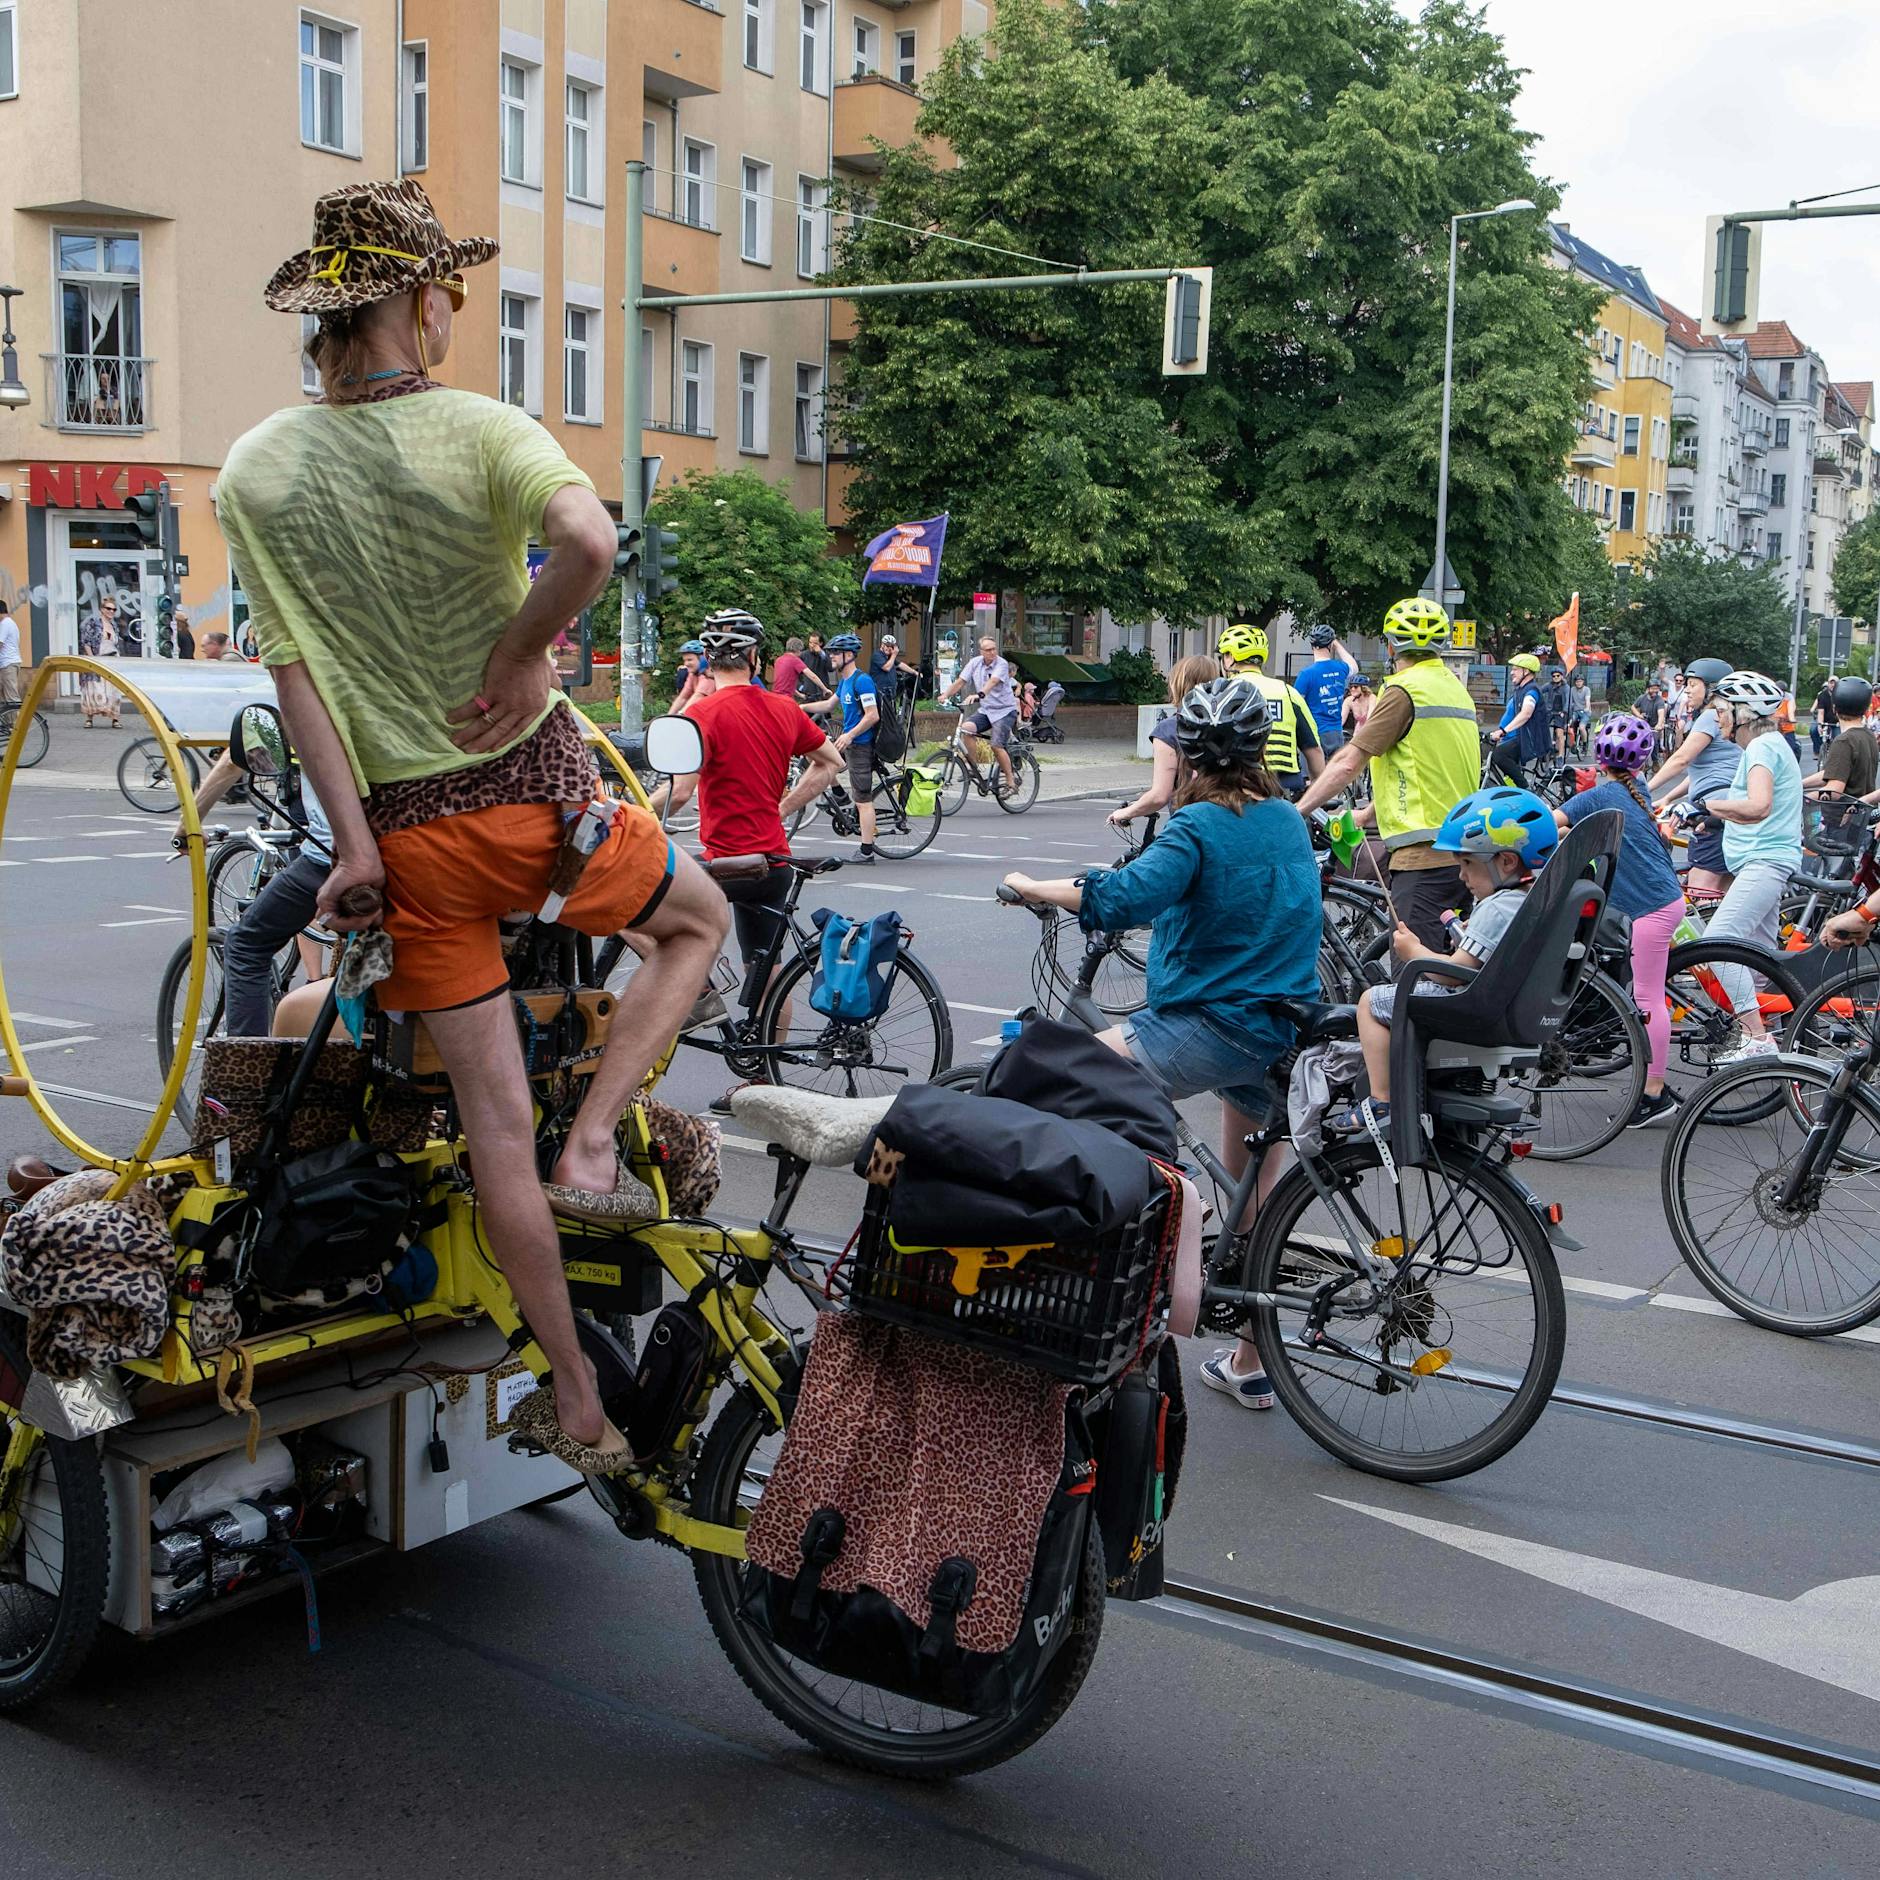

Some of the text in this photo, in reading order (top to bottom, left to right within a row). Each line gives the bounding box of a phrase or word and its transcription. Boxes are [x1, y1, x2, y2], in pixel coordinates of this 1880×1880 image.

[30, 463, 169, 509] NKD
[1398, 769, 1407, 814] CRAFT
[558, 1045, 606, 1068] mont-k.d
[587, 1267, 602, 1277] 750
[605, 1271, 616, 1281] kg
